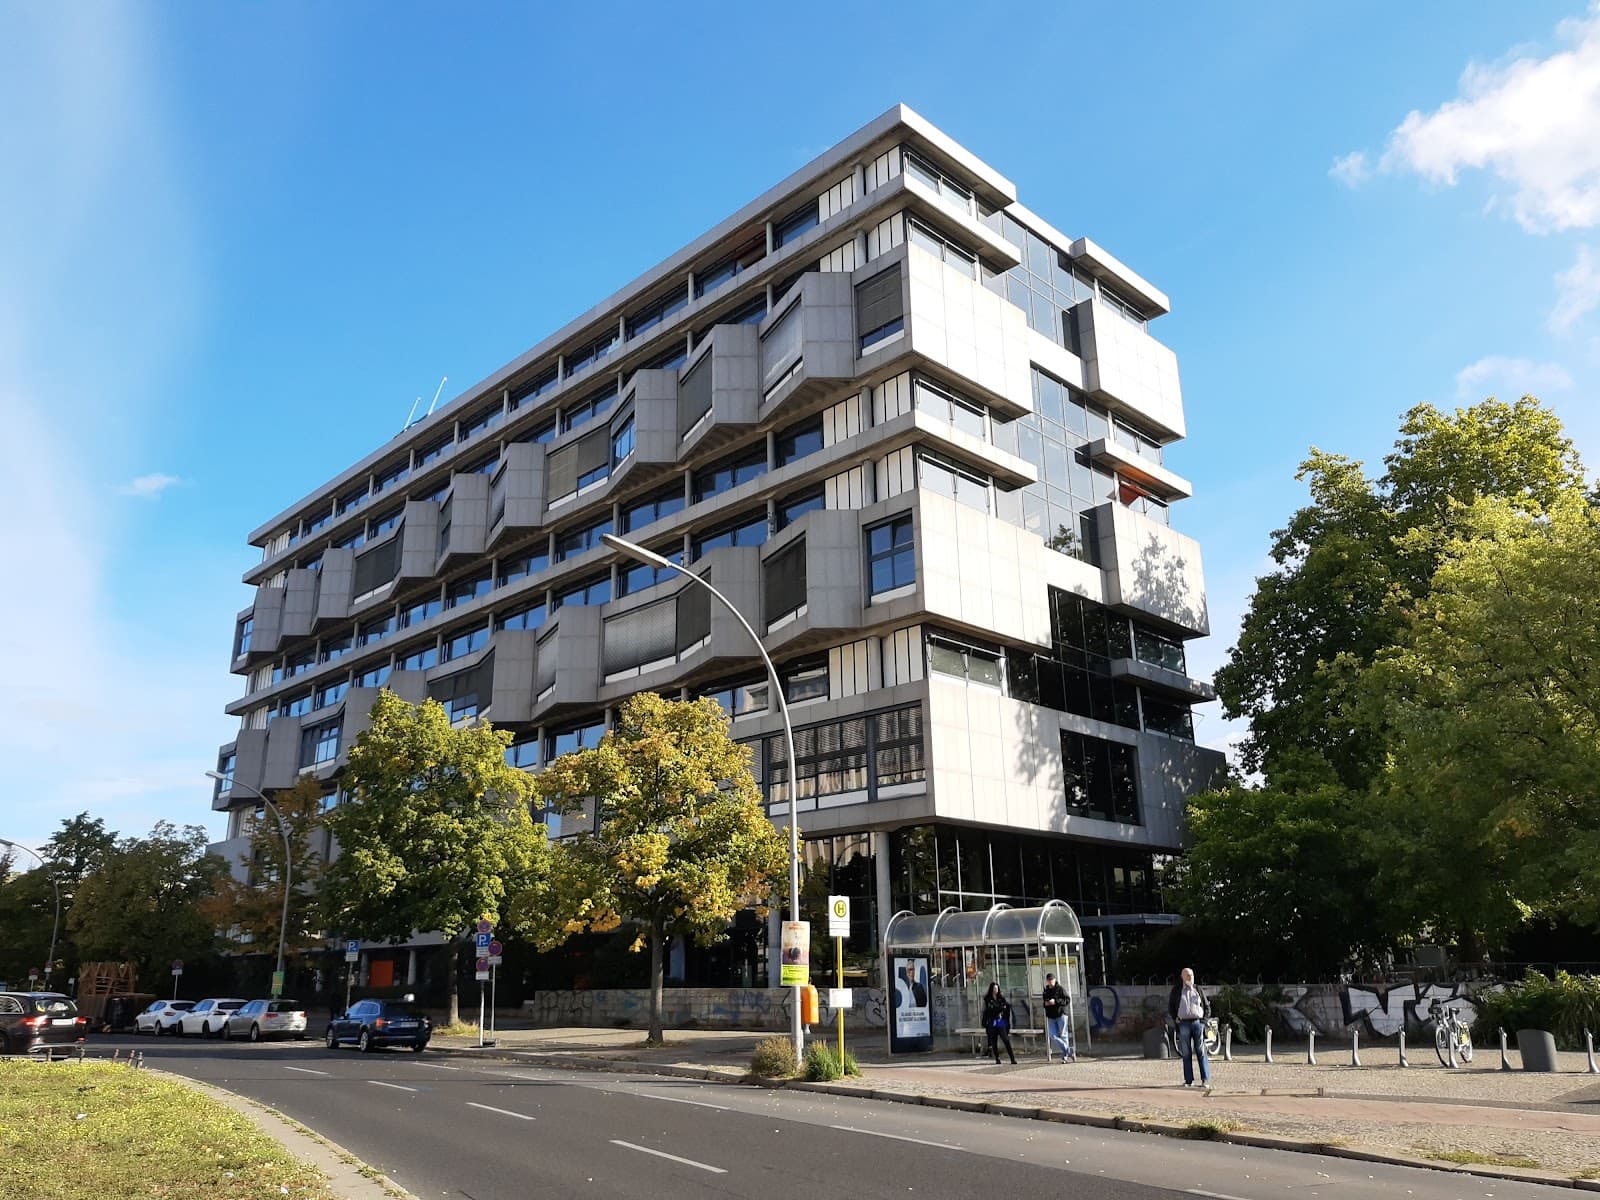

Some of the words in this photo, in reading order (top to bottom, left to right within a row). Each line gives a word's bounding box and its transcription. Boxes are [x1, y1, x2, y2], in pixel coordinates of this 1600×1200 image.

[837, 903, 845, 914] H
[478, 934, 487, 946] P
[348, 941, 356, 951] P
